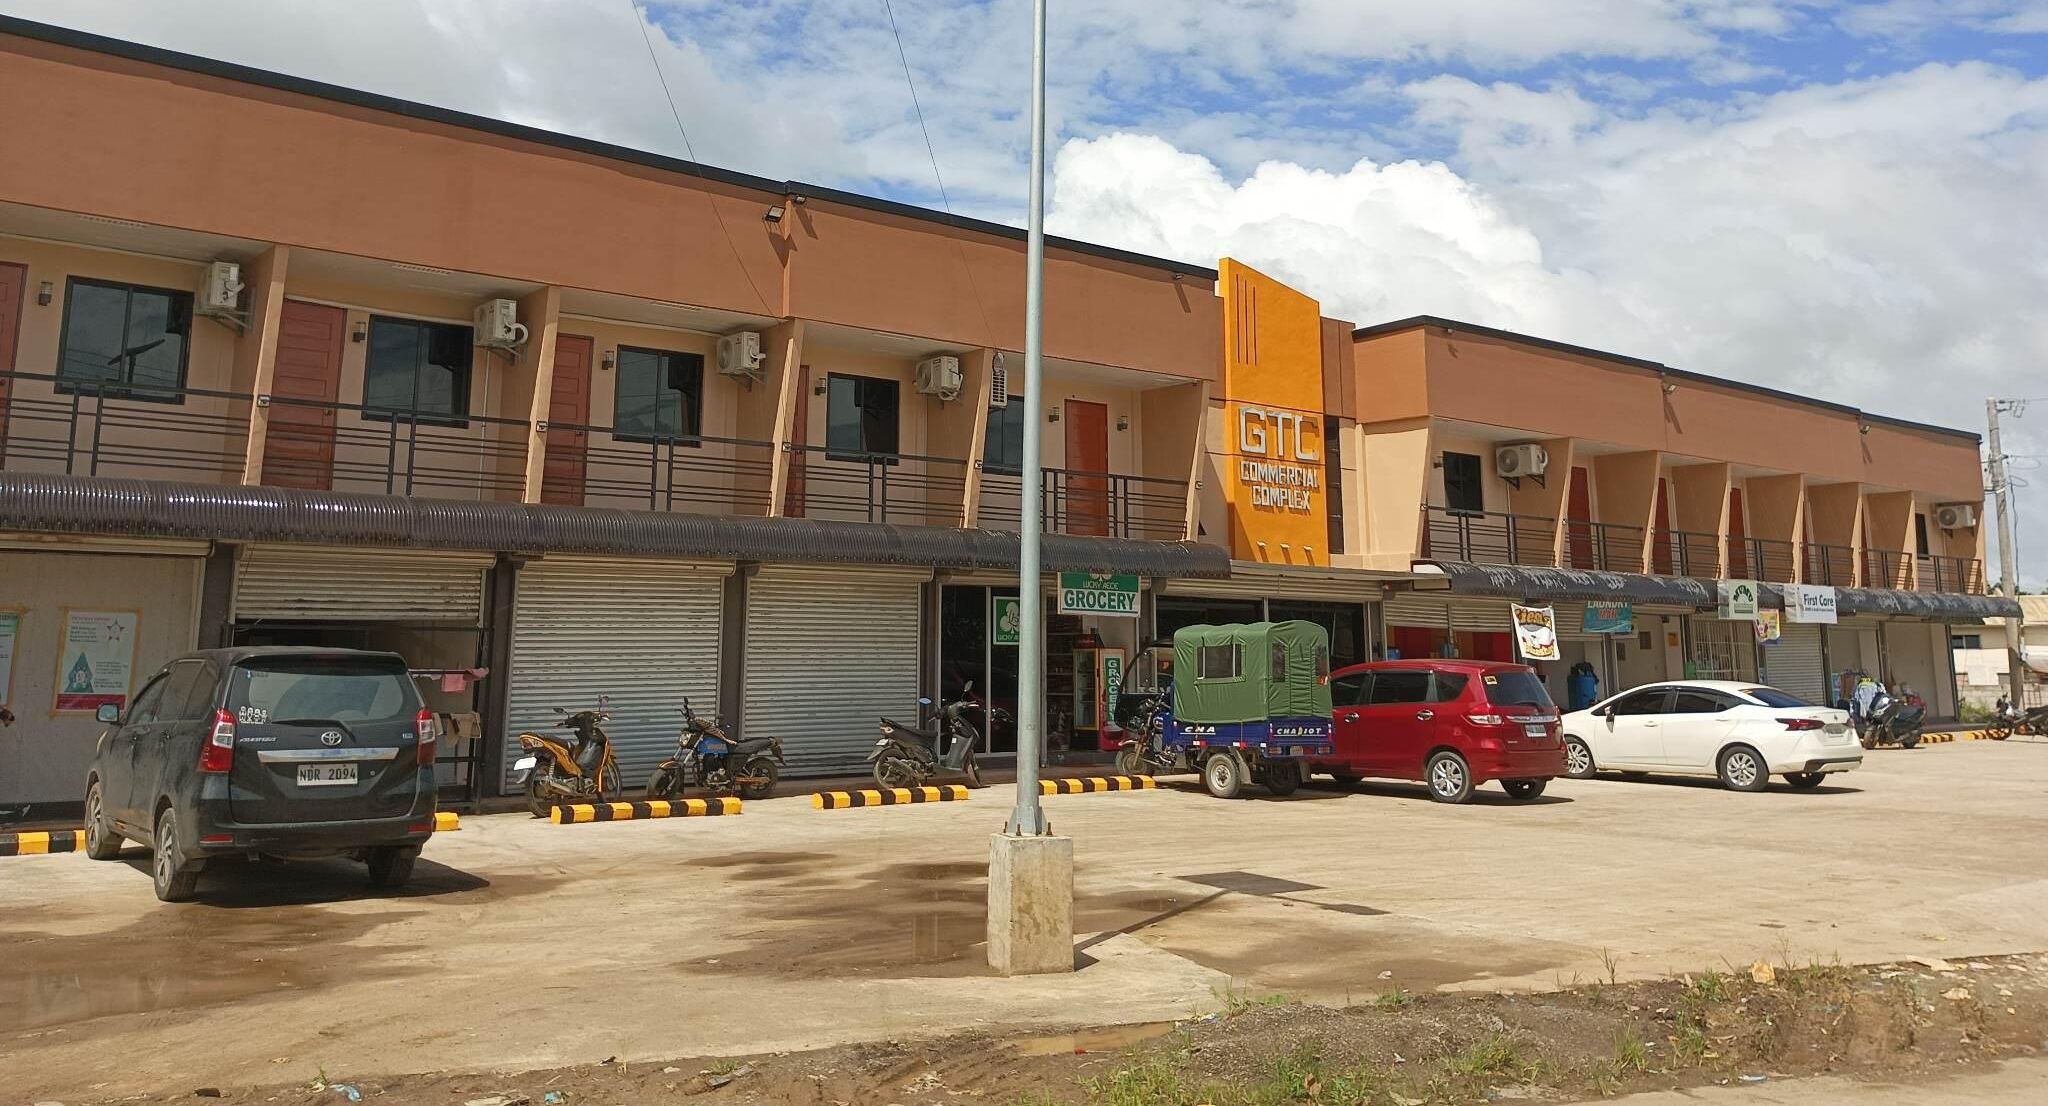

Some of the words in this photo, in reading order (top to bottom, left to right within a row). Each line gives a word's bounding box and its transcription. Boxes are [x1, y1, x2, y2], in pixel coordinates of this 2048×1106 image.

[1240, 407, 1319, 460] GTC
[1240, 460, 1319, 488] COMMERCIAL
[1253, 485, 1311, 510] COMPLEX
[1064, 589, 1136, 611] GROCERY
[1587, 600, 1629, 608] LAUNDRY
[1803, 594, 1818, 606] First
[1819, 594, 1834, 607] Care
[299, 768, 321, 781] NDR
[328, 768, 356, 781] 2094
